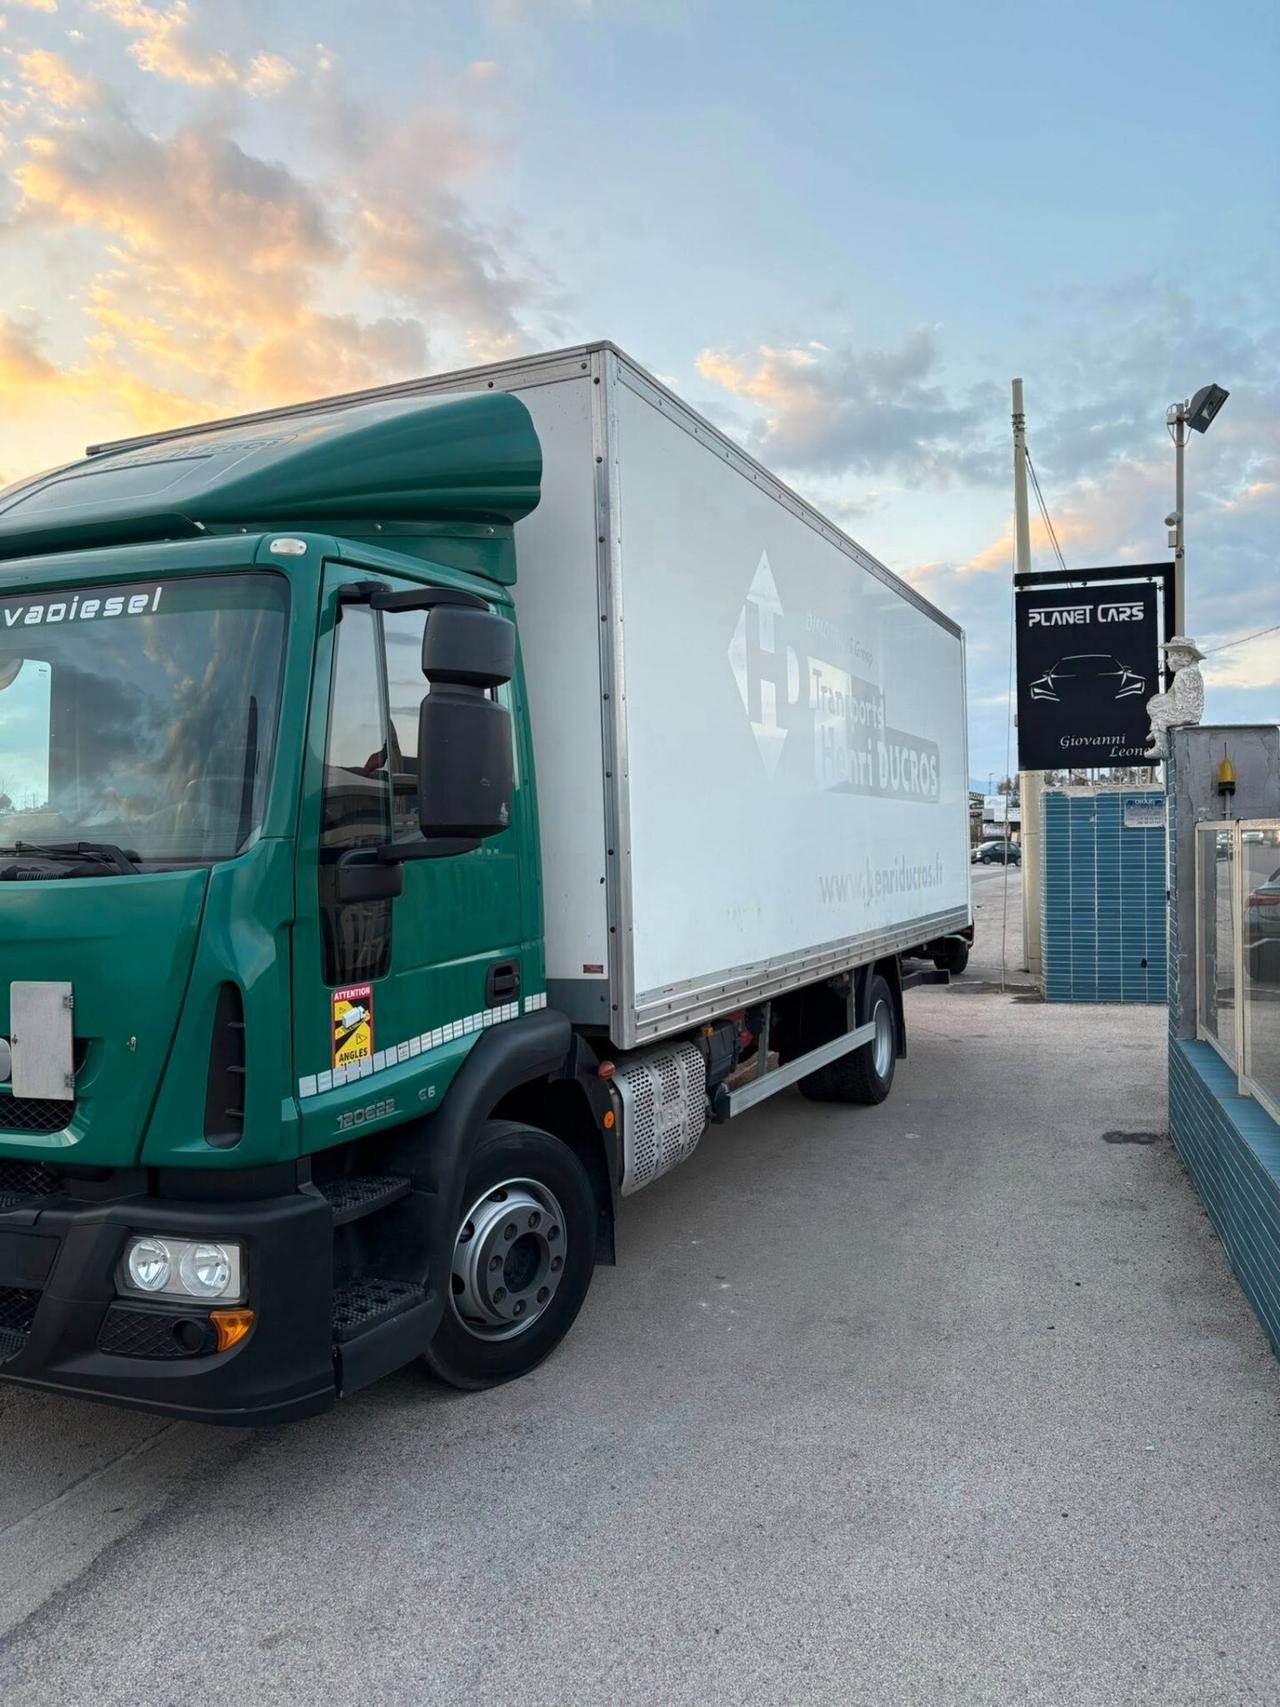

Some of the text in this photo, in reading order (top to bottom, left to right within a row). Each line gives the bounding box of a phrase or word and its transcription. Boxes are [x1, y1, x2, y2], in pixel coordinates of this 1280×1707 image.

[1028, 602, 1144, 627] PLANET CARS
[812, 668, 886, 729] Tranports
[1060, 733, 1127, 749] Giovanni
[877, 740, 938, 796] DUCROS
[334, 986, 371, 1001] ATTENTION
[338, 1047, 368, 1063] ANGLES
[336, 1098, 396, 1130] 120E22
